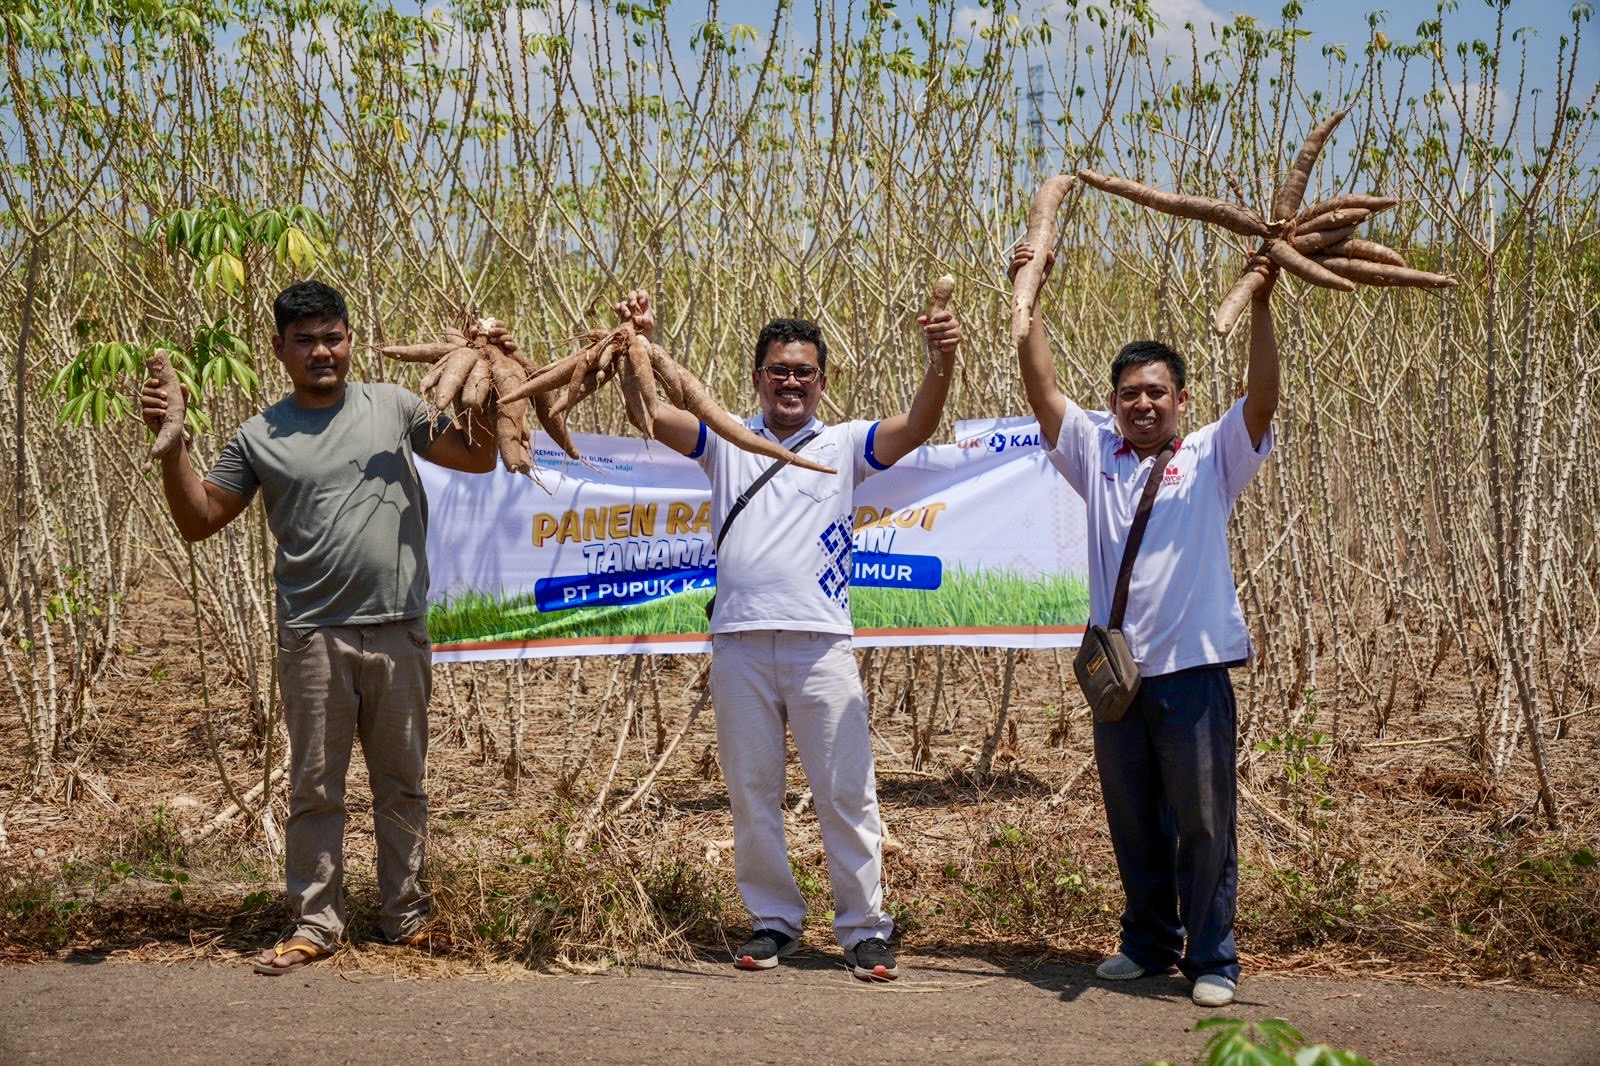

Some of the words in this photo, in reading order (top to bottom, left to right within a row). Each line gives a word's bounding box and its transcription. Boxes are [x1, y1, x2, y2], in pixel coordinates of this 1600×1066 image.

[589, 455, 613, 464] BUMN
[615, 464, 633, 472] Maju
[532, 503, 659, 547] PANEN
[583, 538, 717, 575] TANAMA
[562, 585, 591, 604] PT
[598, 578, 675, 599] PUPUK
[851, 562, 913, 582] IMUR
